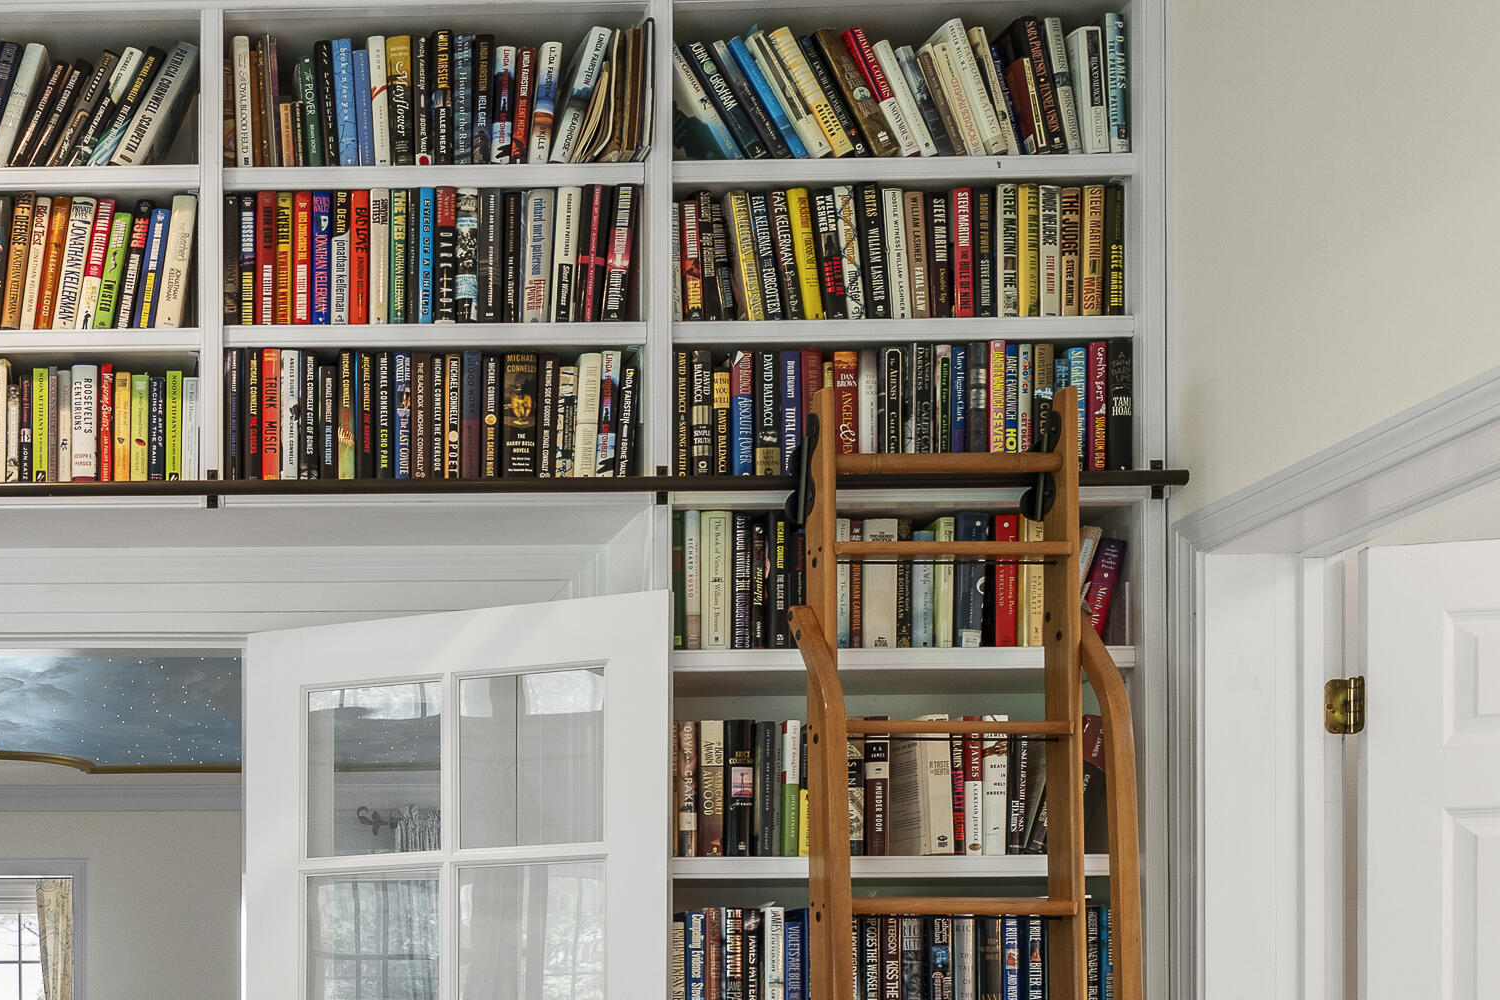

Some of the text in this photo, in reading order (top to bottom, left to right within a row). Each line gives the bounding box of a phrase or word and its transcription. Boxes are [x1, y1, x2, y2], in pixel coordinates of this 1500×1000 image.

[1116, 35, 1124, 45] D.
[340, 47, 349, 121] broken for you
[690, 42, 738, 111] JOHN GRISHAM
[854, 28, 876, 62] PRIMARY
[870, 65, 892, 98] COLORS
[1116, 51, 1126, 89] JAMES
[83, 96, 111, 144] THE LINCOLN LAWYER
[124, 48, 188, 154] PATRICIA CORNWELL SCARPETTA
[305, 83, 315, 114] PLOVER
[393, 61, 408, 136] Mayflower
[12, 193, 31, 246] SELF-DEFENSE
[32, 205, 47, 245] Blood Test
[337, 192, 346, 233] DR. DEATH
[891, 192, 899, 218] HOSTILE
[58, 223, 87, 321] JONATHAN KELLERMAN
[1062, 194, 1078, 305] THE JUDGE STEVE MARTINI
[100, 279, 116, 311] TWISTED
[335, 239, 346, 312] jonathan kellerman
[74, 382, 82, 431] CENTURIONS
[83, 378, 92, 434] ROOSEVELT'S
[763, 354, 773, 426] DAVID BALDACCI
[265, 377, 277, 454] TRUNK MUSIC
[738, 397, 753, 464] ABSOLUTE POWER
[399, 429, 408, 474] LAST COYOTE
[852, 564, 860, 630] JONATHAN CARROLL
[683, 726, 692, 754] ORYX
[684, 770, 694, 808] CRAKE
[875, 786, 883, 831] MURDER ROOM
[690, 914, 703, 947] Compelling
[690, 950, 703, 978] Evidence
[886, 960, 899, 979] KISS
[1030, 962, 1042, 986] BITTER
[691, 982, 703, 1000] Steve
[886, 981, 899, 997] THE
